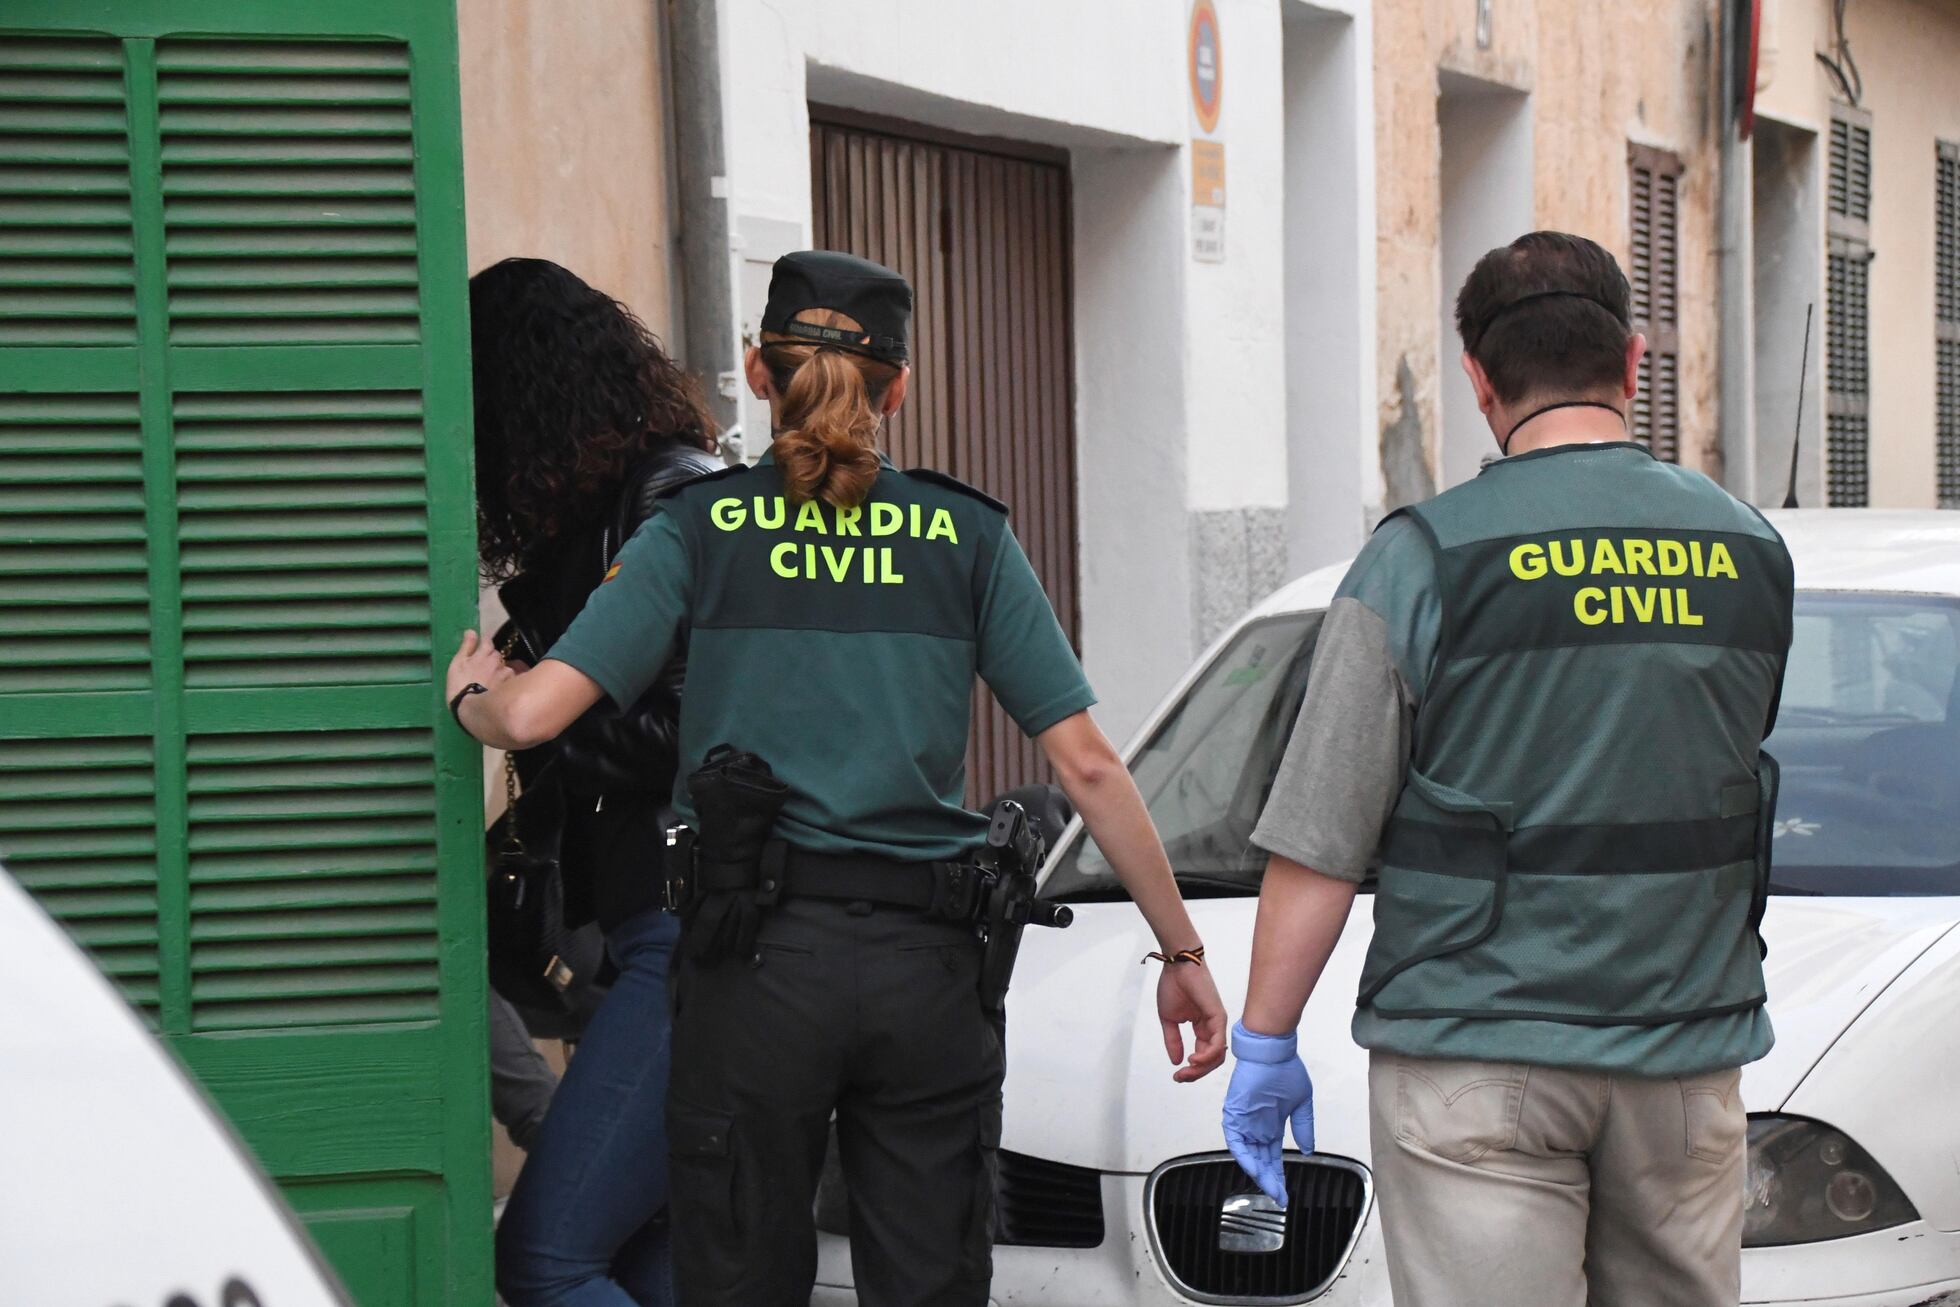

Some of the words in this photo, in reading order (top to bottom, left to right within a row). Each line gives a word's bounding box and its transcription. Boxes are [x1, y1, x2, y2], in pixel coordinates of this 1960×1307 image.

[823, 329, 843, 341] CIVIL
[711, 496, 958, 544] GUARDIA
[770, 542, 904, 584] CIVIL
[1508, 538, 1738, 579] GUARDIA
[1573, 586, 1704, 626] CIVIL
